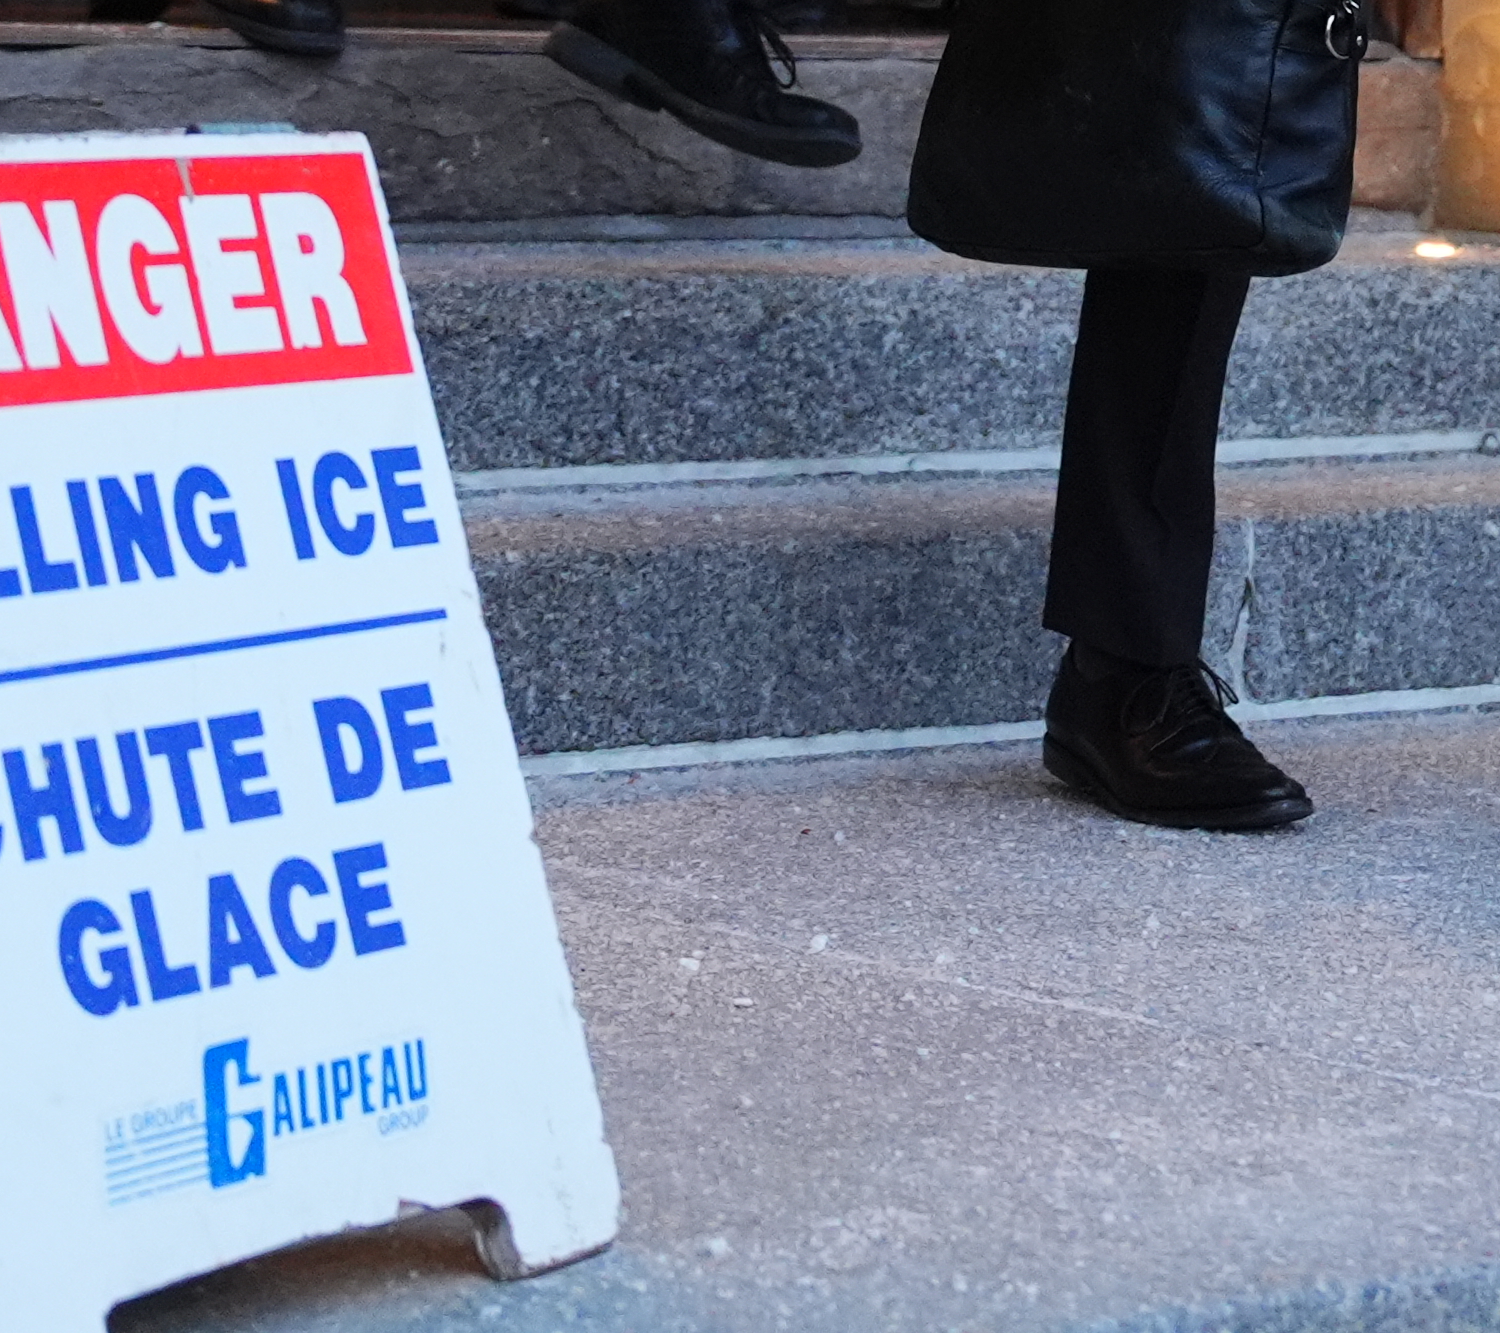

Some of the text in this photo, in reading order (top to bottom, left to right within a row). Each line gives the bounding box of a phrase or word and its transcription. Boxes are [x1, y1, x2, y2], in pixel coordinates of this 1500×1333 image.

[274, 444, 441, 562] ICE
[311, 681, 454, 806] DE
[56, 841, 408, 1019] GLACE
[103, 1098, 197, 1142] LE GROUPE
[378, 1104, 429, 1135] GROUP
